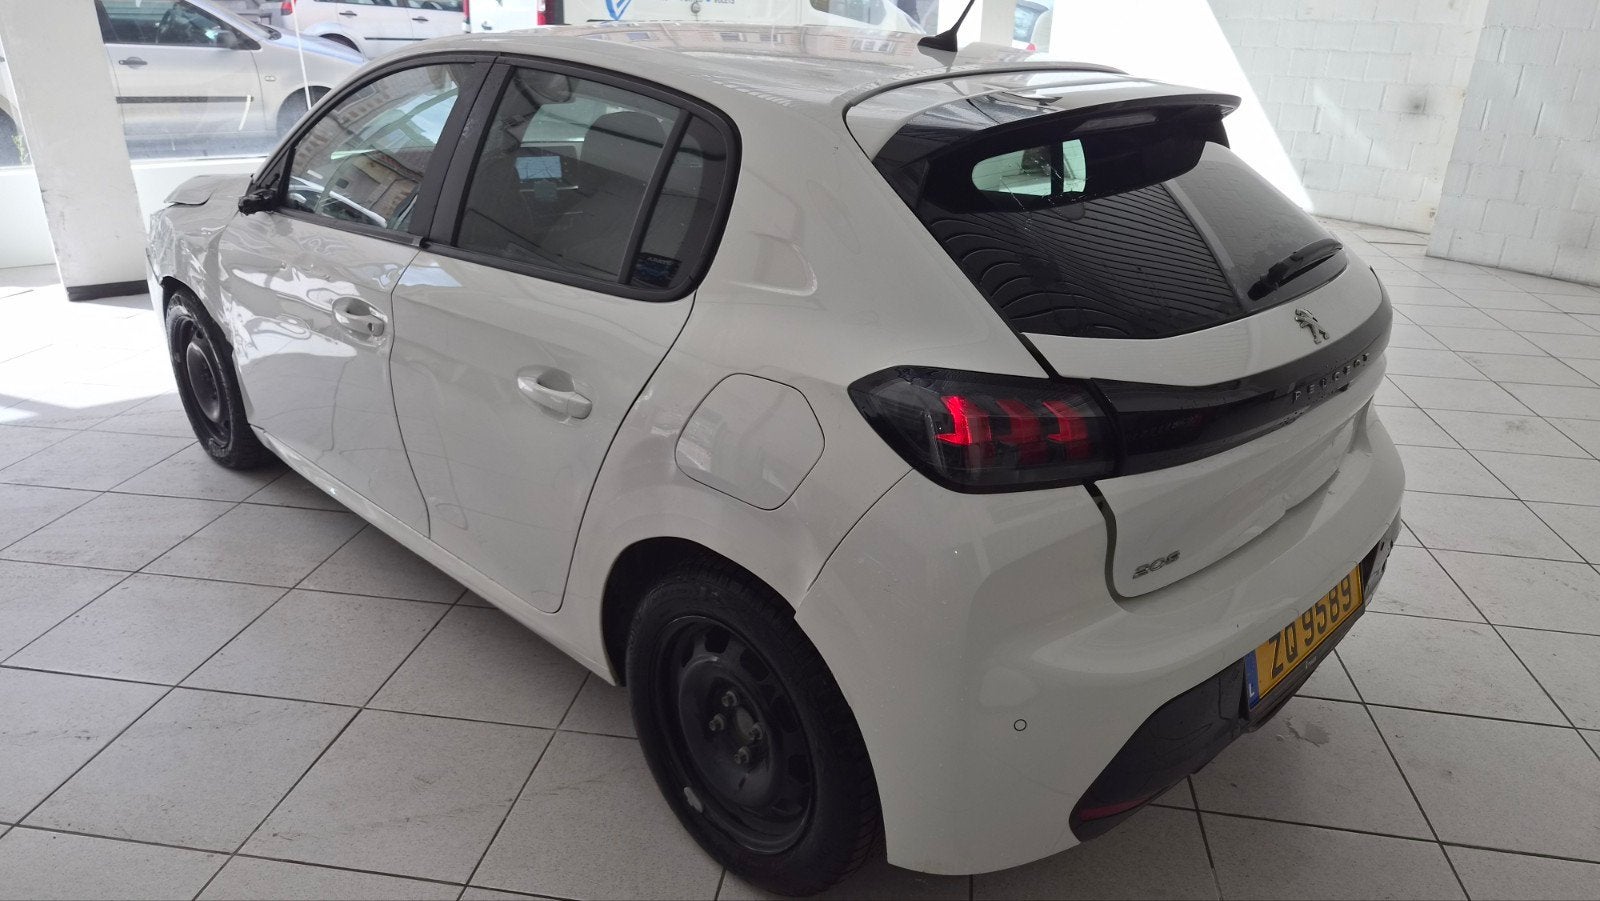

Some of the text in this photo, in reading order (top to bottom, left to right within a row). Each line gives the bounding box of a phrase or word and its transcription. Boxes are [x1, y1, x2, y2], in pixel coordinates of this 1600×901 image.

[1291, 353, 1370, 404] PEUGEOT
[1268, 574, 1352, 679] ZQ 9589
